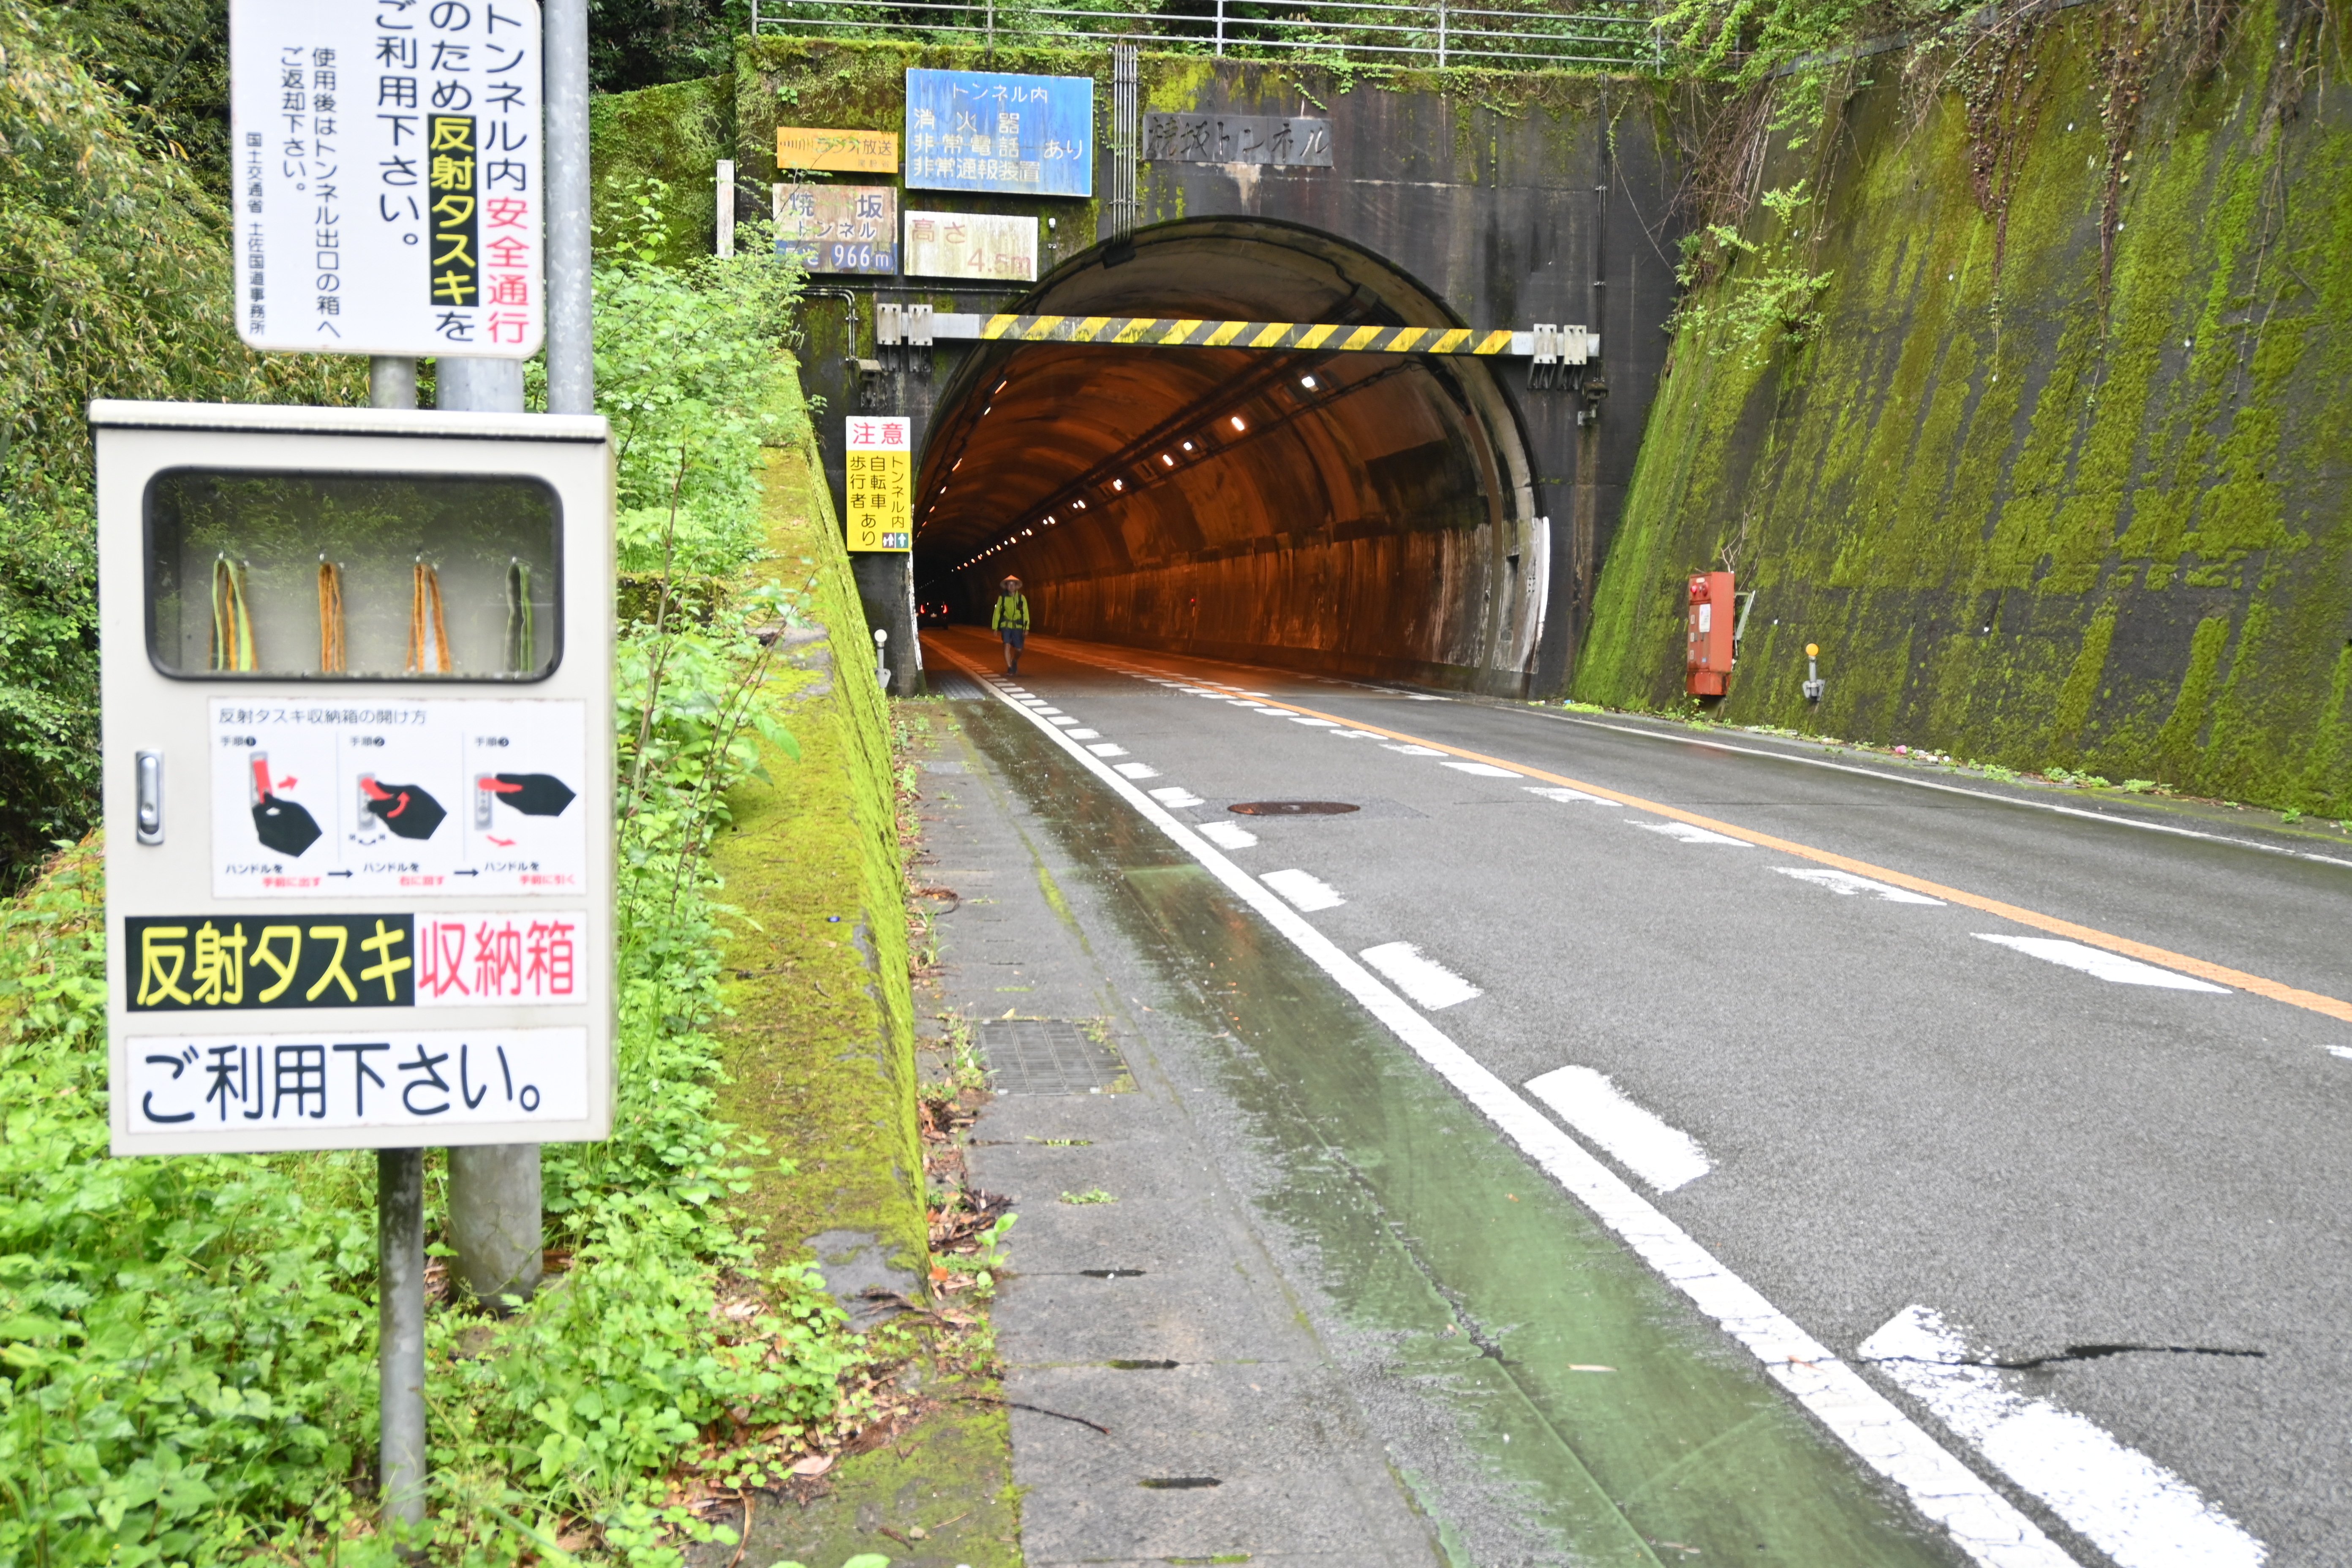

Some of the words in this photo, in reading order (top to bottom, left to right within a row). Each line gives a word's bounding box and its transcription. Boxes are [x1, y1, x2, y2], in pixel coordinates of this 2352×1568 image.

[953, 82, 1048, 103] トンネル内
[281, 46, 306, 191] ご返却下さい。
[376, 0, 419, 245] ご利用下さい。
[914, 132, 1020, 158] 非常電話
[1043, 139, 1083, 161] あり
[246, 132, 264, 214] 国土交通省
[914, 156, 1040, 182] 非常通報装置
[312, 47, 341, 338] 使用後はトンネル出口の箱へ
[799, 220, 876, 239] トンネル
[912, 218, 965, 244] 高さ
[248, 222, 265, 335] 土佐国道事務所
[968, 248, 1031, 279] 4.5m
[853, 422, 903, 445] 注意
[850, 455, 866, 509] 歩行者
[870, 456, 887, 509] 自転車
[891, 456, 904, 528] トンネル内
[861, 513, 877, 546] あり
[219, 708, 426, 724] 反射タスキ収納箱の開け方
[142, 1043, 540, 1124] ご利用下さい。
